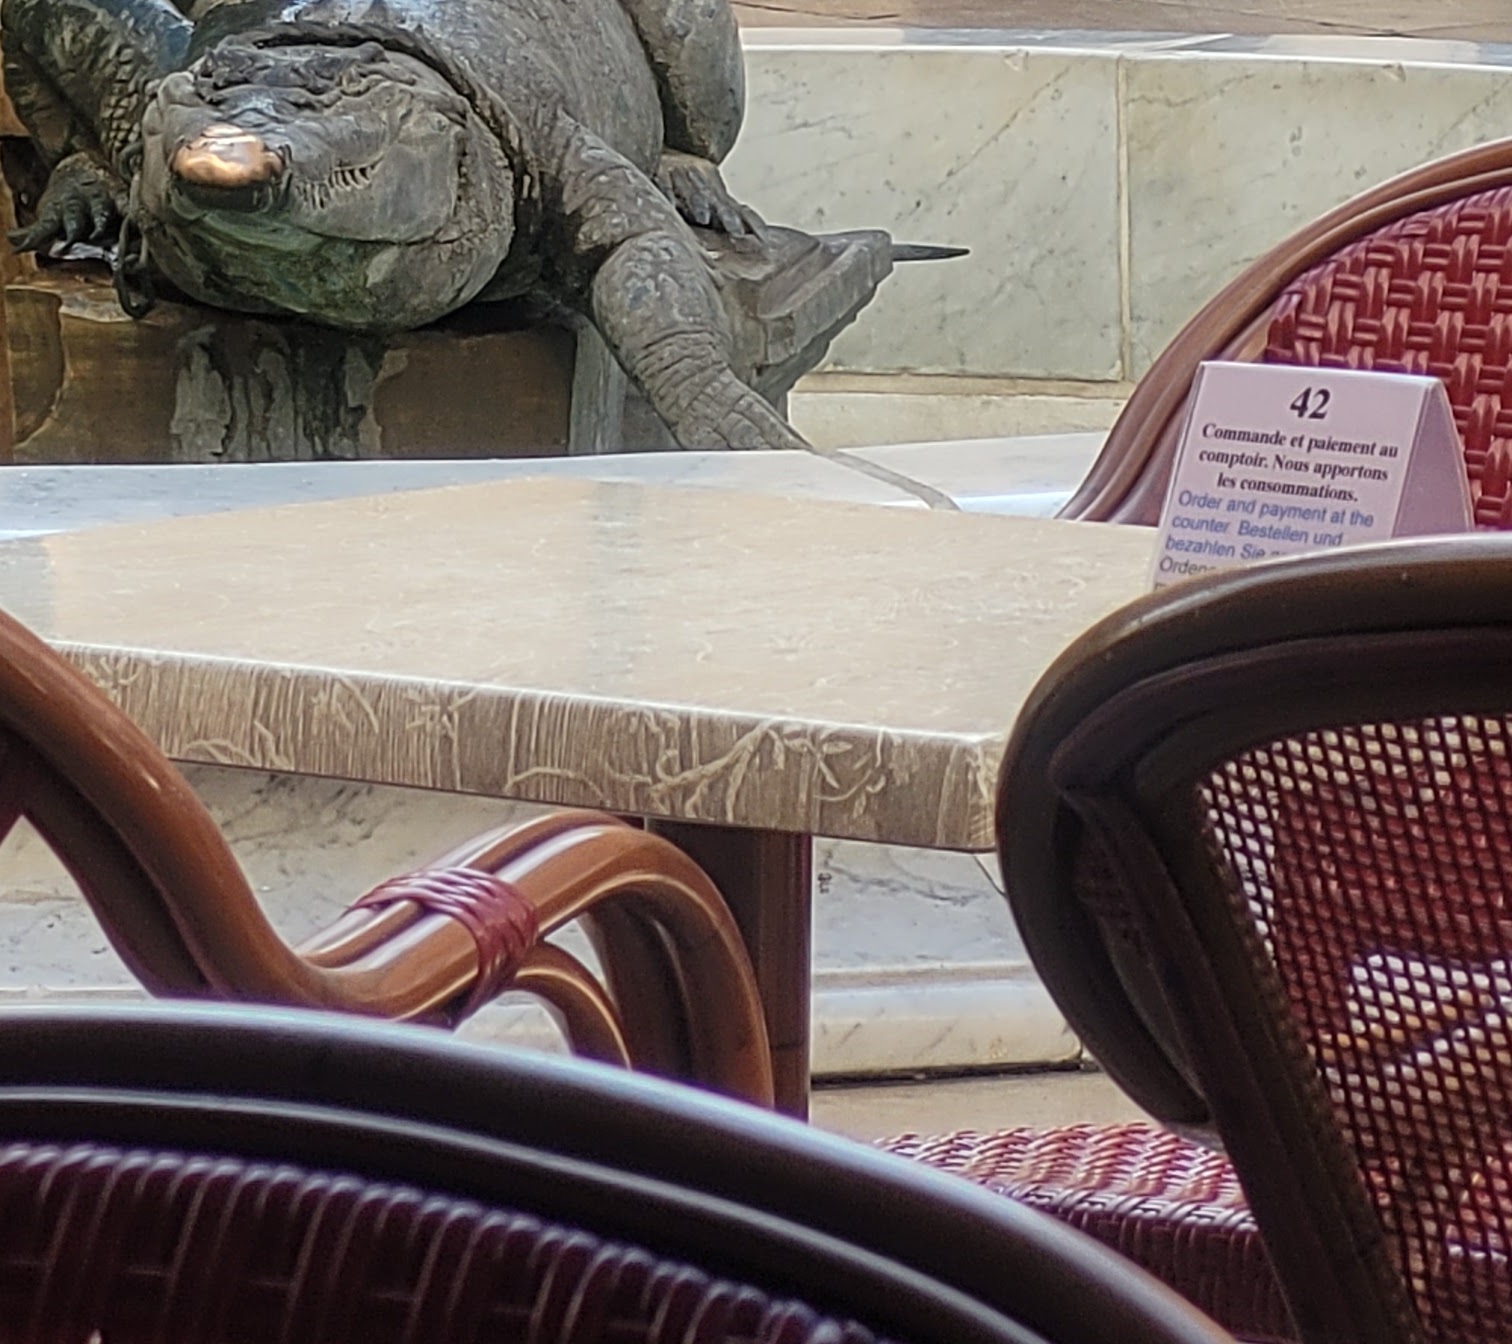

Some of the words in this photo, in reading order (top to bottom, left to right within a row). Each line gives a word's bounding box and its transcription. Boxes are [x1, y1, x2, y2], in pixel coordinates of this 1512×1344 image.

[1289, 386, 1331, 420] 42
[1202, 423, 1287, 447] Commande
[1290, 435, 1304, 448] et
[1307, 436, 1376, 456] paiement
[1379, 444, 1399, 458] au
[1199, 449, 1269, 469] comptoir.
[1273, 454, 1309, 473] Nous
[1313, 463, 1389, 481] apportons
[1217, 472, 1236, 488] les
[1240, 479, 1358, 502] consommations.
[1178, 490, 1223, 509] Order
[1226, 498, 1256, 514] and
[1259, 503, 1328, 522] payment
[1330, 509, 1346, 524] at
[1350, 510, 1374, 527] the
[1172, 515, 1230, 533] counter
[1238, 520, 1309, 544] Bestellen
[1313, 532, 1344, 547] und
[1165, 535, 1235, 558] bezahlen
[1240, 543, 1266, 560] Sie
